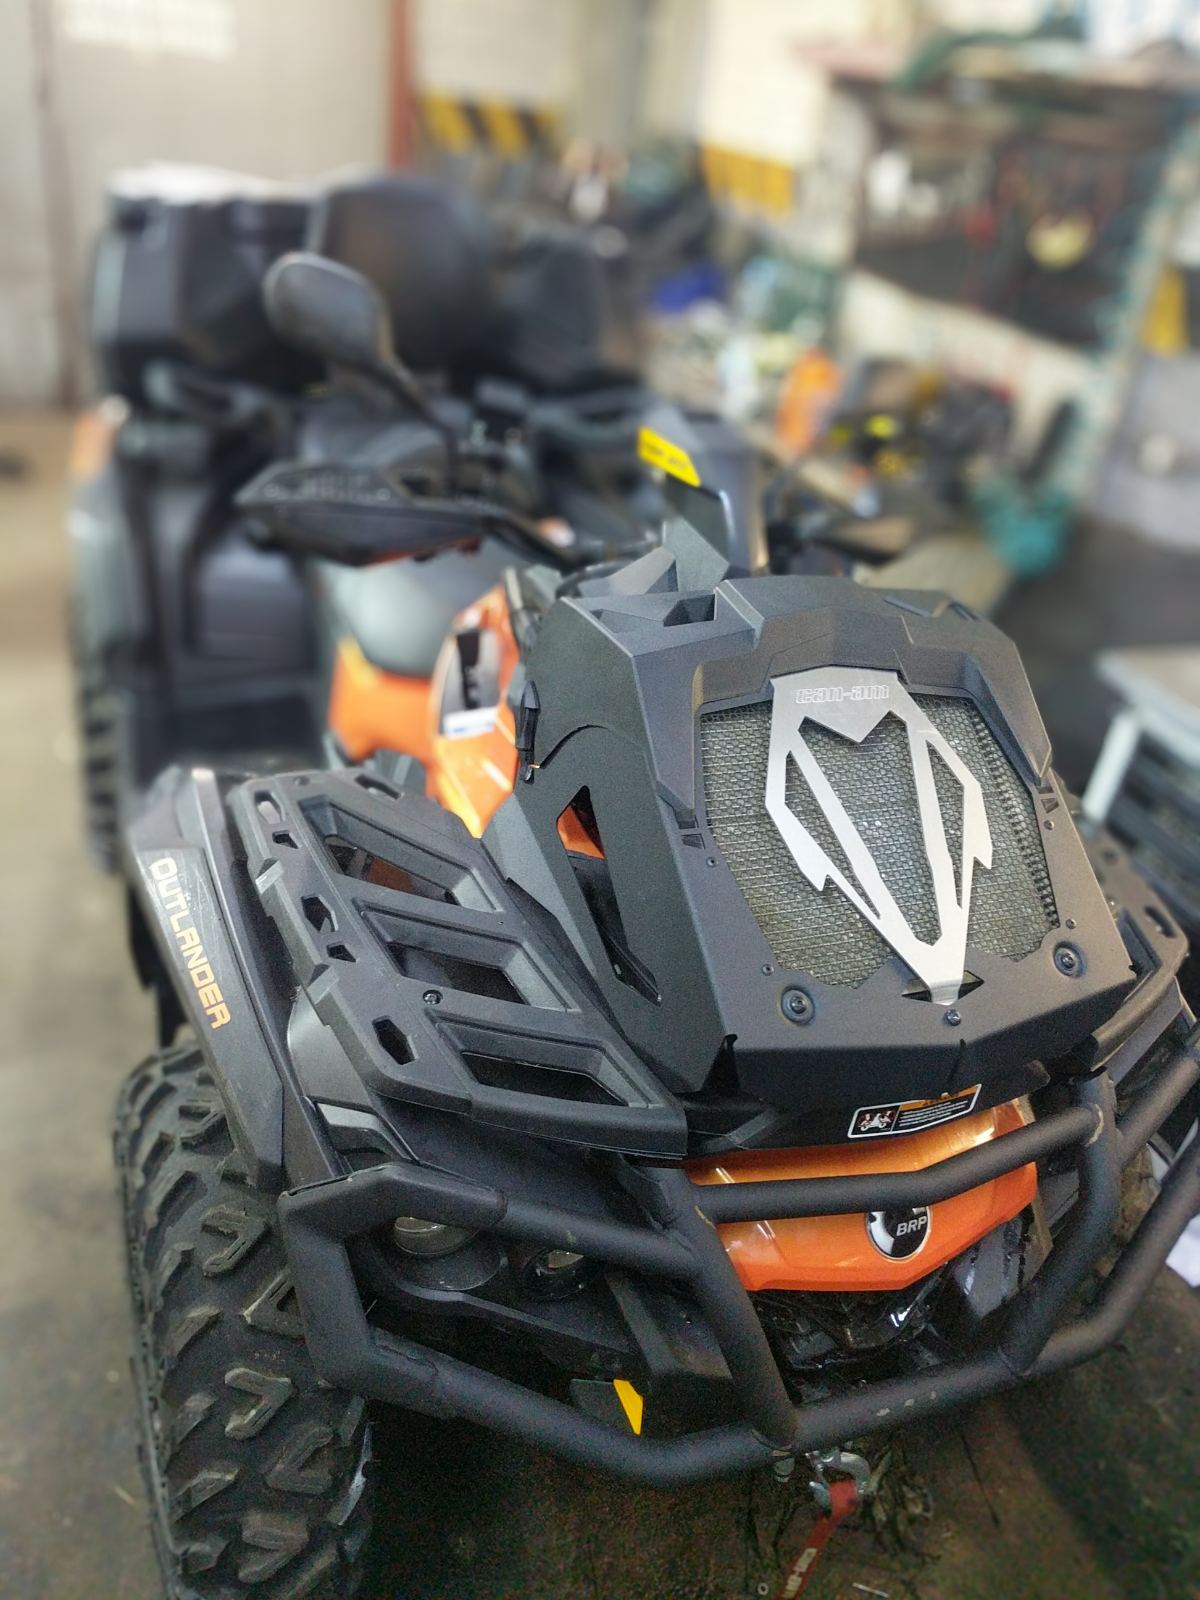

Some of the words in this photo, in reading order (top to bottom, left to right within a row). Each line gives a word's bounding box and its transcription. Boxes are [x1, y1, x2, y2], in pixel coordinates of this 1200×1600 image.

[796, 685, 889, 703] can-am
[148, 857, 231, 1029] OUTLANDER
[896, 1216, 928, 1236] BRP
